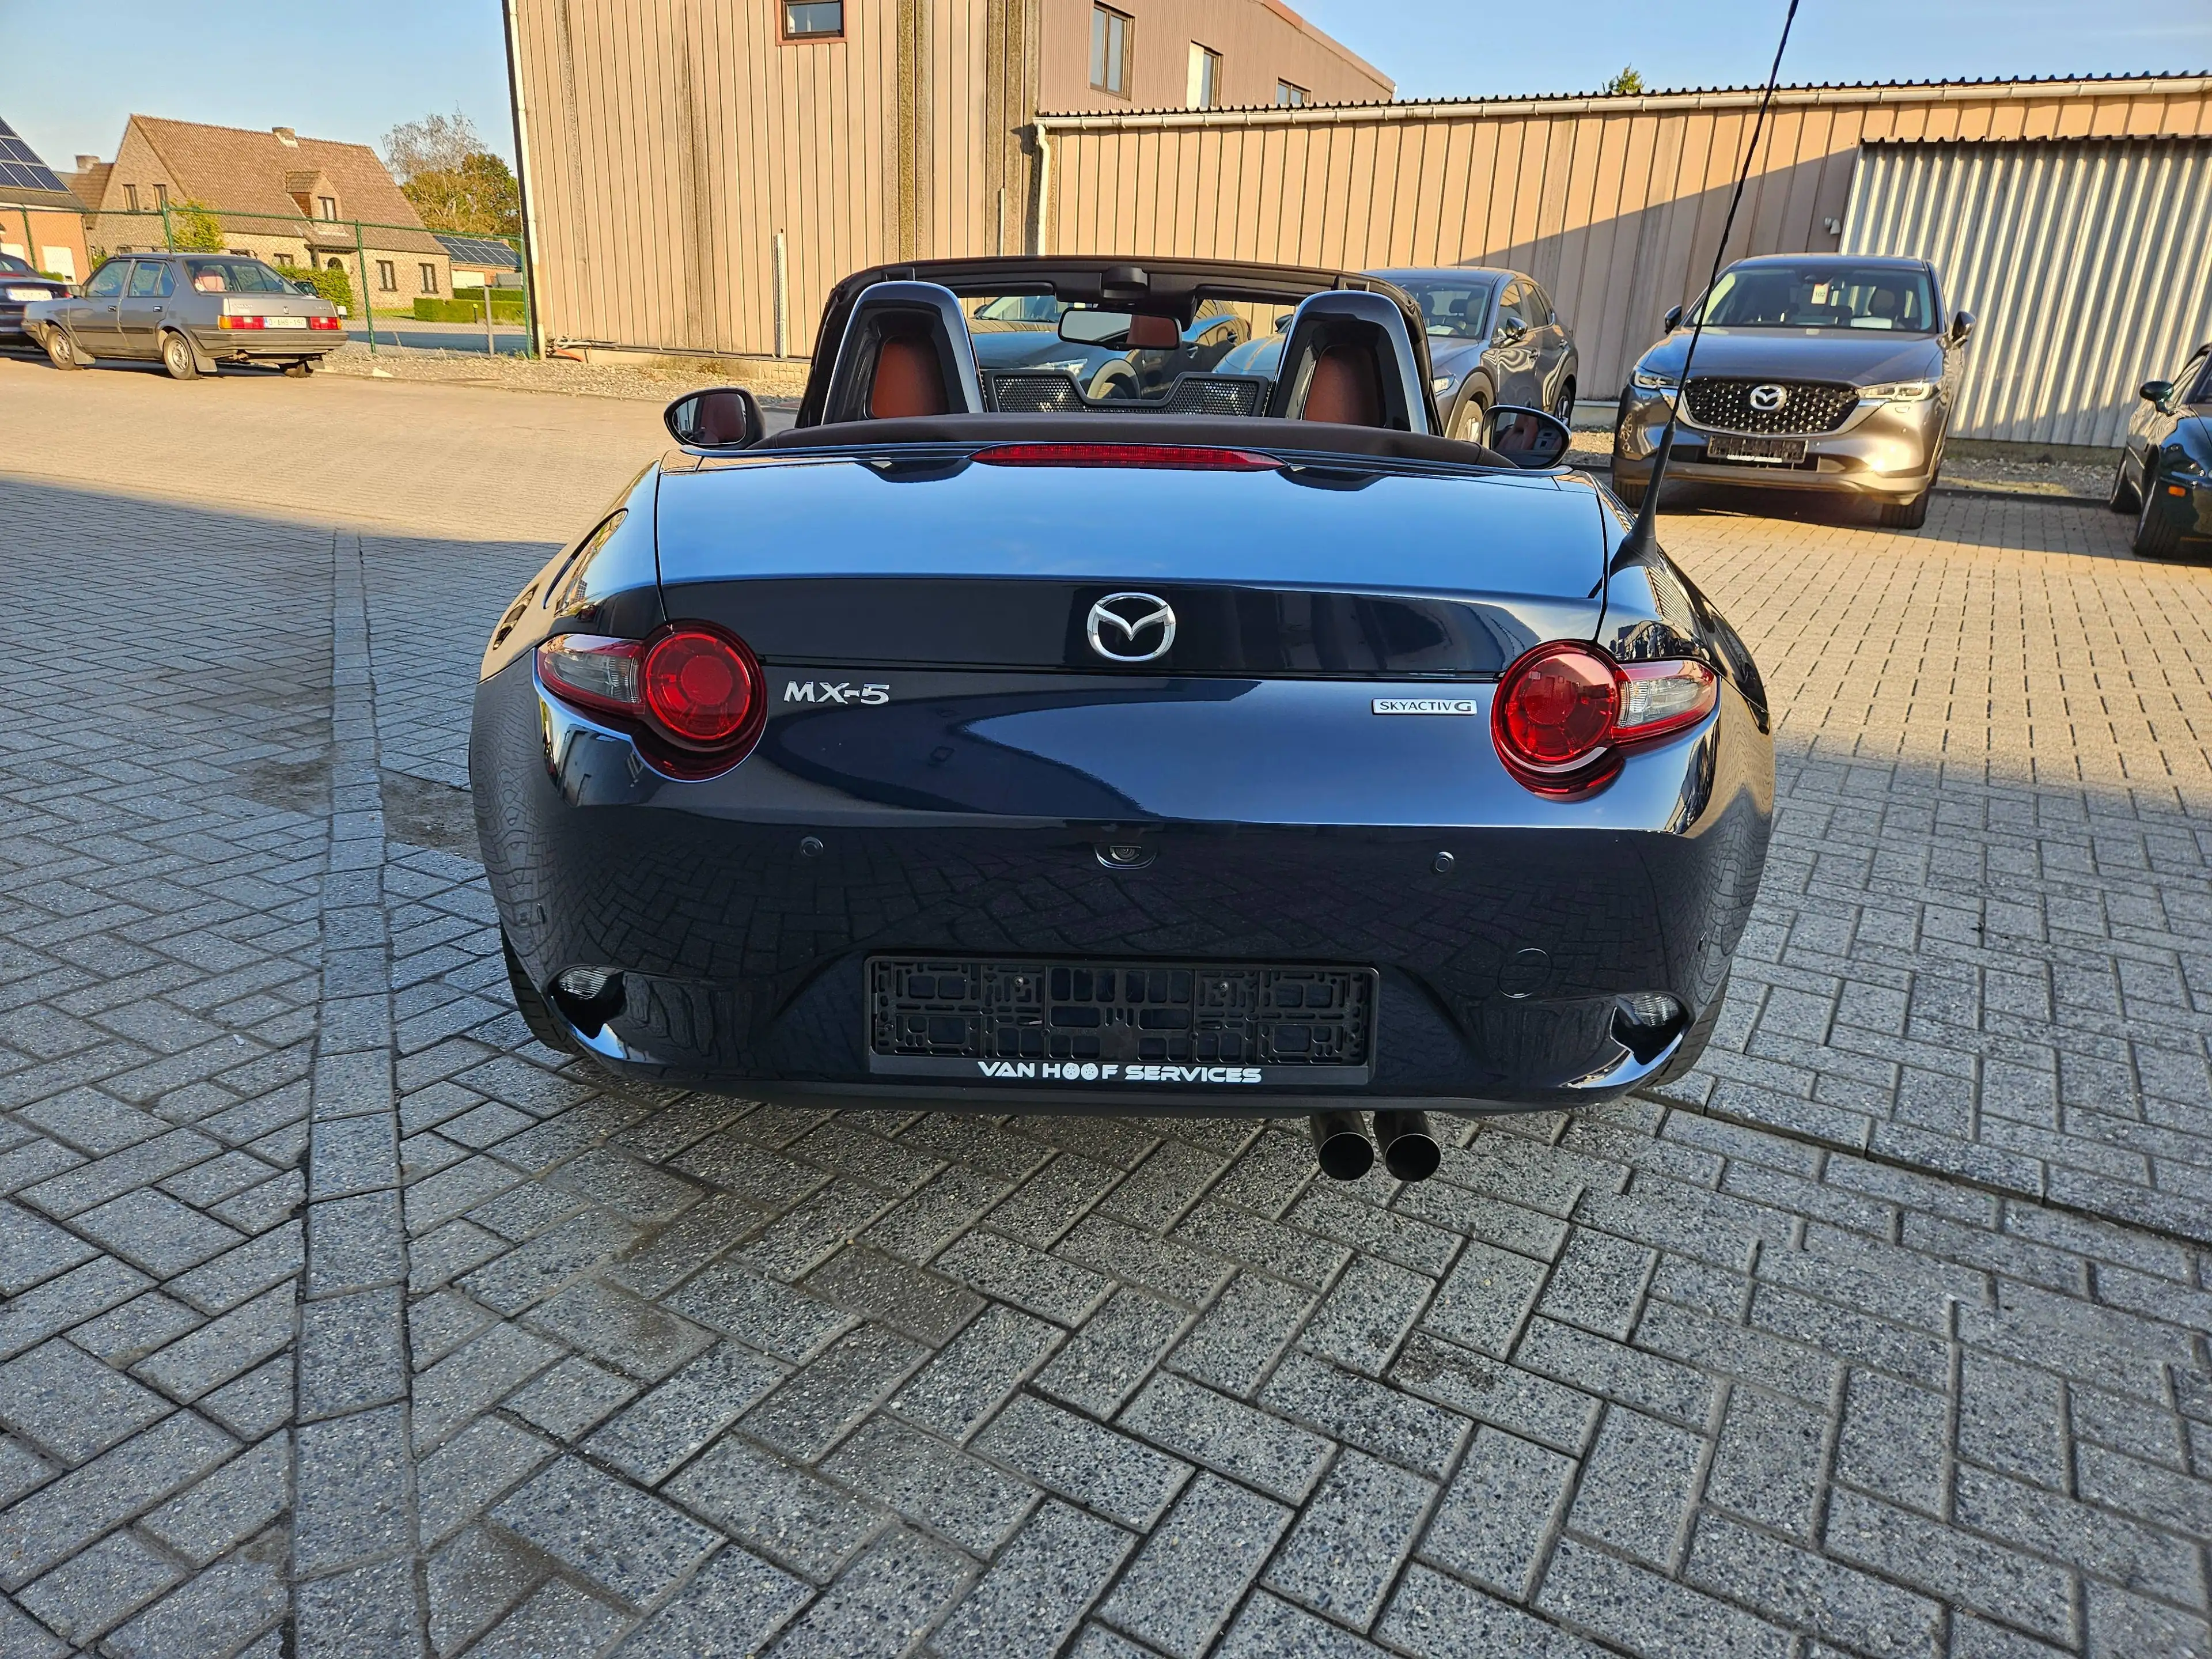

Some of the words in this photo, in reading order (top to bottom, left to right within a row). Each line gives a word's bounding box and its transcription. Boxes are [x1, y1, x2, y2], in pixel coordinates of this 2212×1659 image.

[783, 681, 890, 704] MX-5
[977, 1060, 1036, 1078] VAN
[1042, 1062, 1119, 1080] HOOF
[1126, 1065, 1262, 1083] SERVICES
